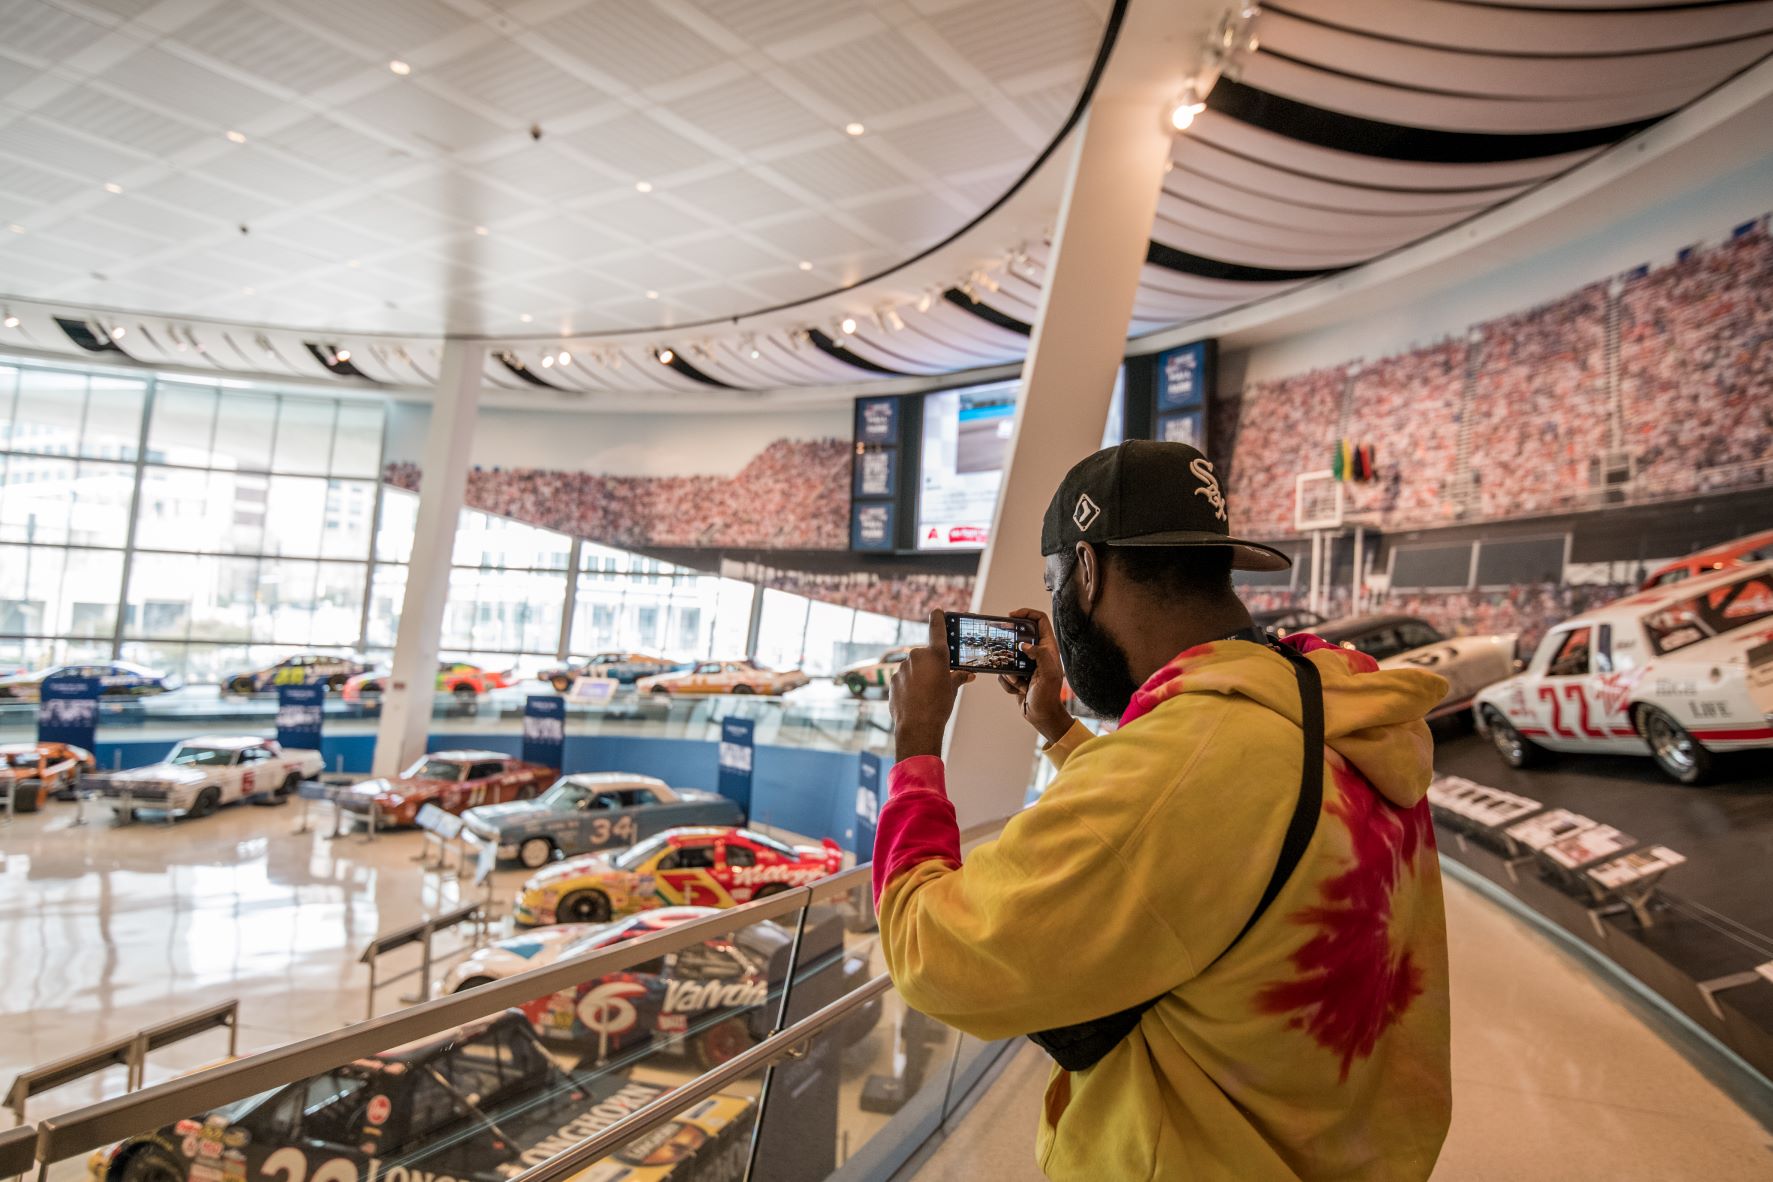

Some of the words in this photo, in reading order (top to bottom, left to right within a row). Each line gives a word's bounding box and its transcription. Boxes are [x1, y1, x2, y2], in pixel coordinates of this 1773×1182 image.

[1190, 458, 1227, 522] Sox
[590, 816, 633, 845] 34
[577, 981, 648, 1034] 6
